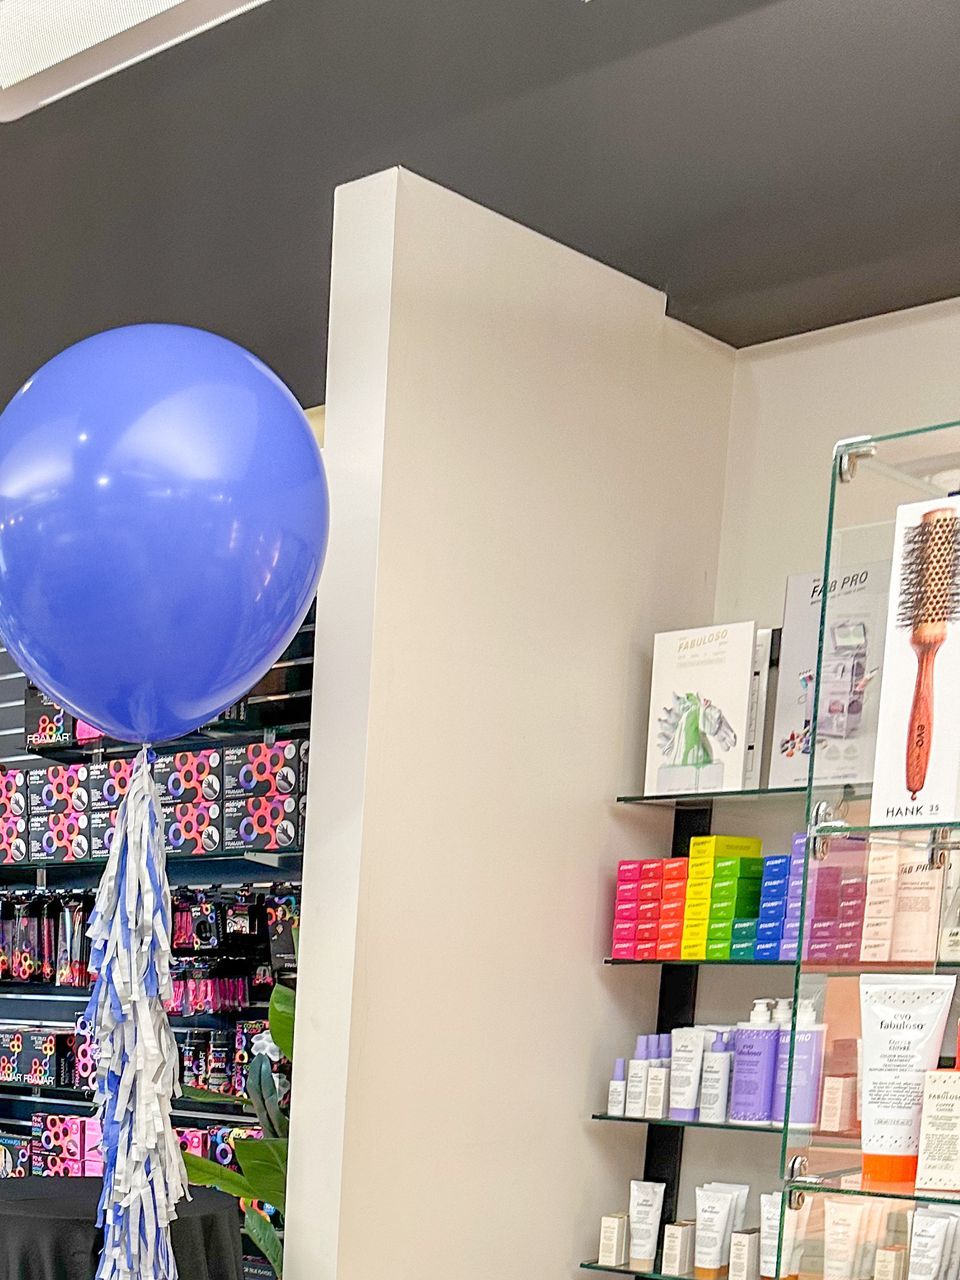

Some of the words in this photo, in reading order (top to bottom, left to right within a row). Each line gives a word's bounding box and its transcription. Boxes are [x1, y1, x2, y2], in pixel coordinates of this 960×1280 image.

[841, 570, 869, 590] PRO
[678, 629, 728, 651] FABULOSO
[27, 733, 69, 744] FRAMAR
[916, 724, 925, 748] evo
[886, 805, 923, 818] HANK
[880, 1020, 924, 1031] fabuloso
[23, 1074, 55, 1086] FRAMAR
